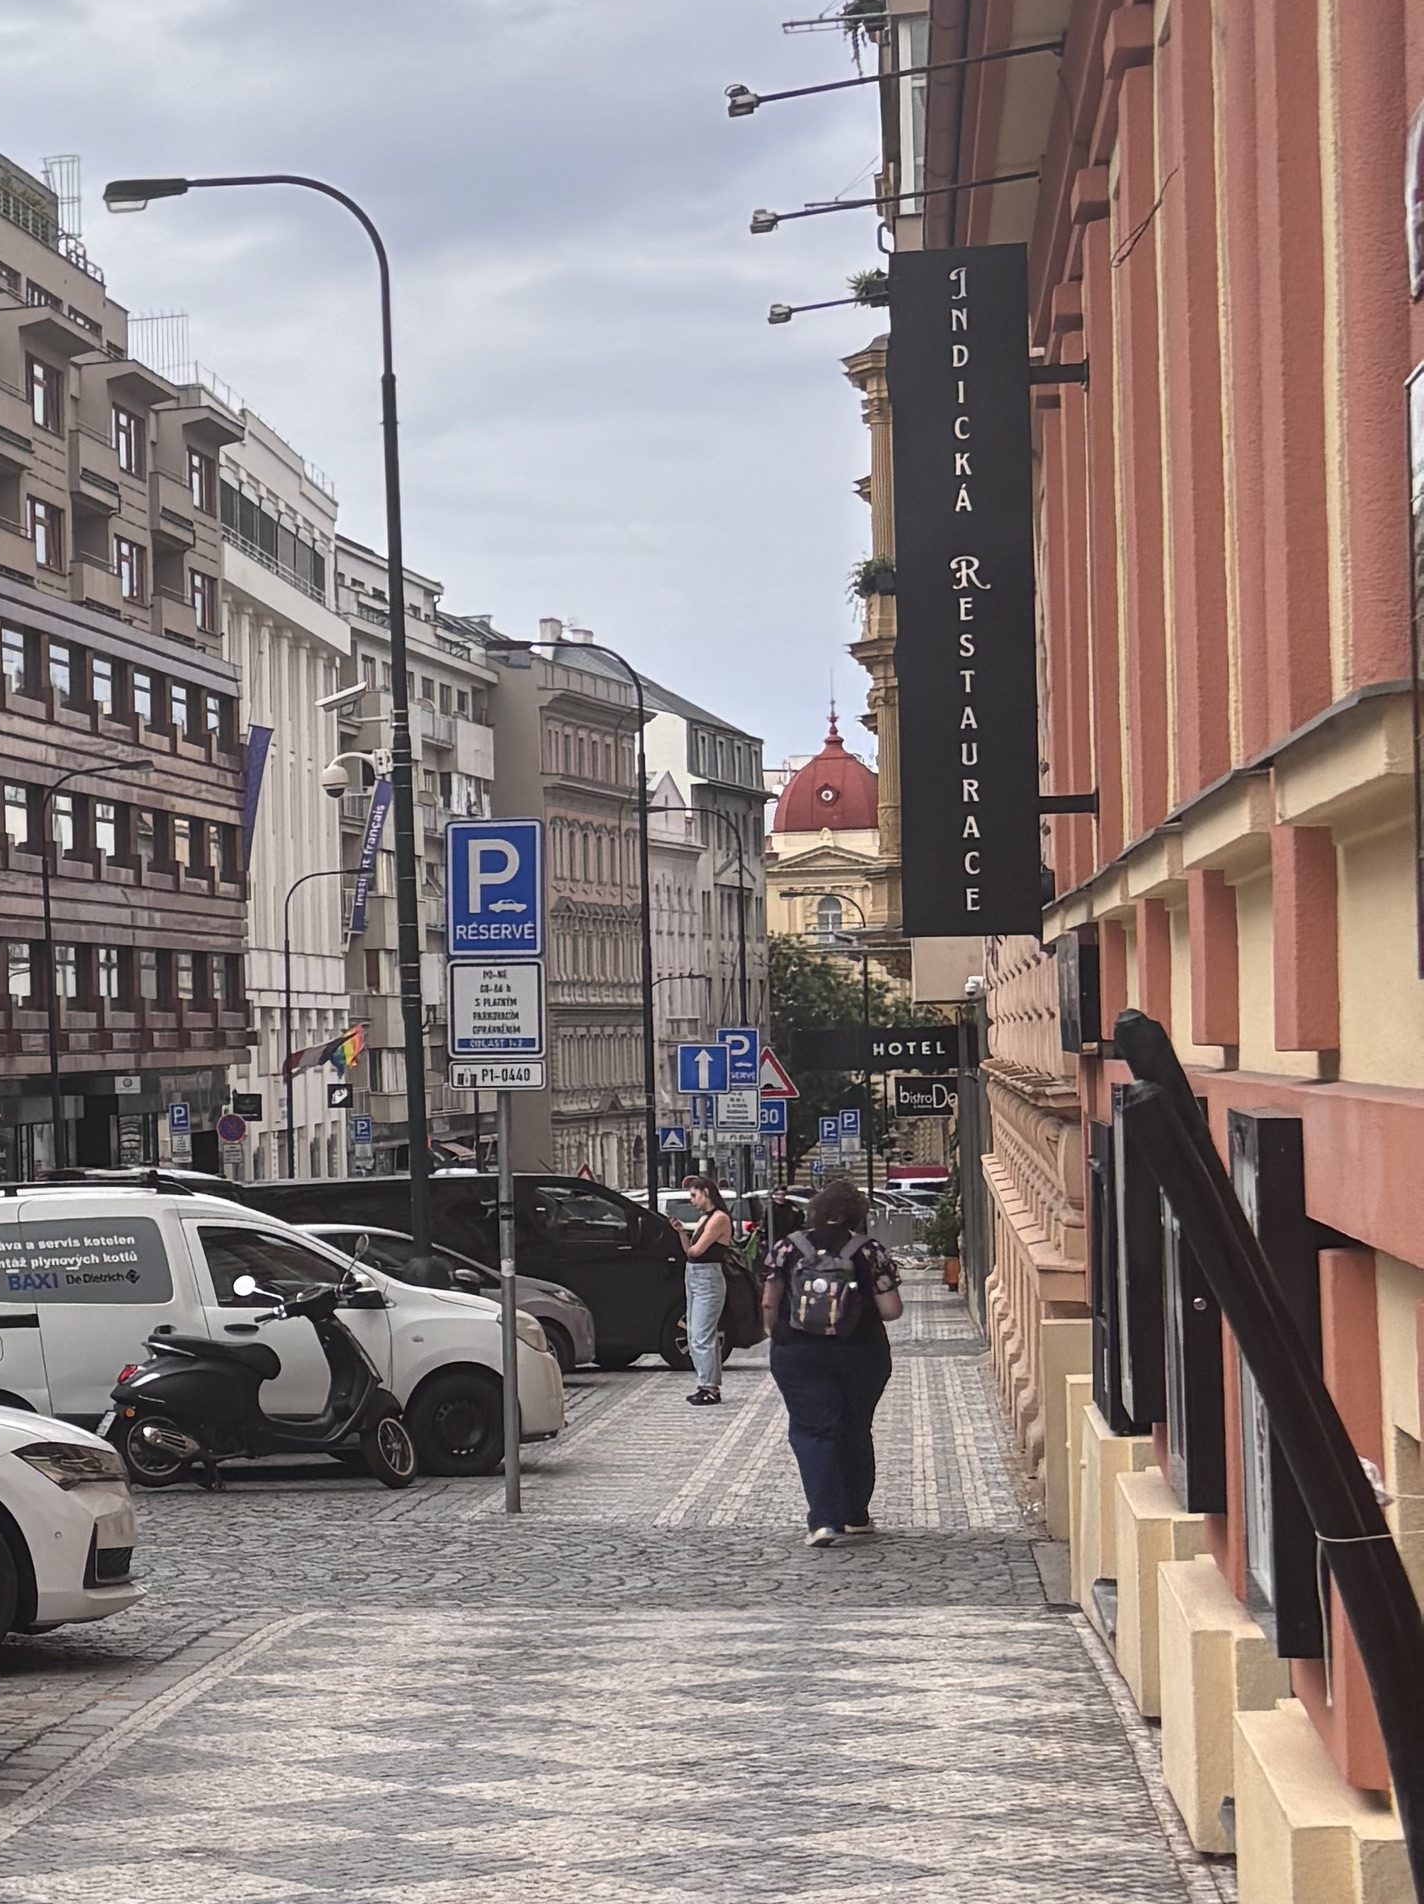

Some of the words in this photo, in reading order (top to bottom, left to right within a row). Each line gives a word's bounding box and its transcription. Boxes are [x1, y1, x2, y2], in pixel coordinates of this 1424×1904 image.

[948, 265, 973, 514] INDICKÁ
[949, 554, 992, 914] RESTAURACE
[363, 803, 386, 856] français
[468, 839, 520, 914] P
[455, 921, 536, 940] RÉSERVÉ
[474, 997, 481, 1007] S
[872, 1041, 946, 1056] HOTEL
[481, 1067, 531, 1083] P1-0440
[760, 1109, 779, 1125] 30
[26, 1241, 35, 1250] a
[38, 1237, 81, 1250] servis
[83, 1235, 137, 1247] kotelen
[30, 1252, 100, 1270] plynových
[103, 1249, 138, 1264] kotlů
[7, 1272, 59, 1291] BAXI
